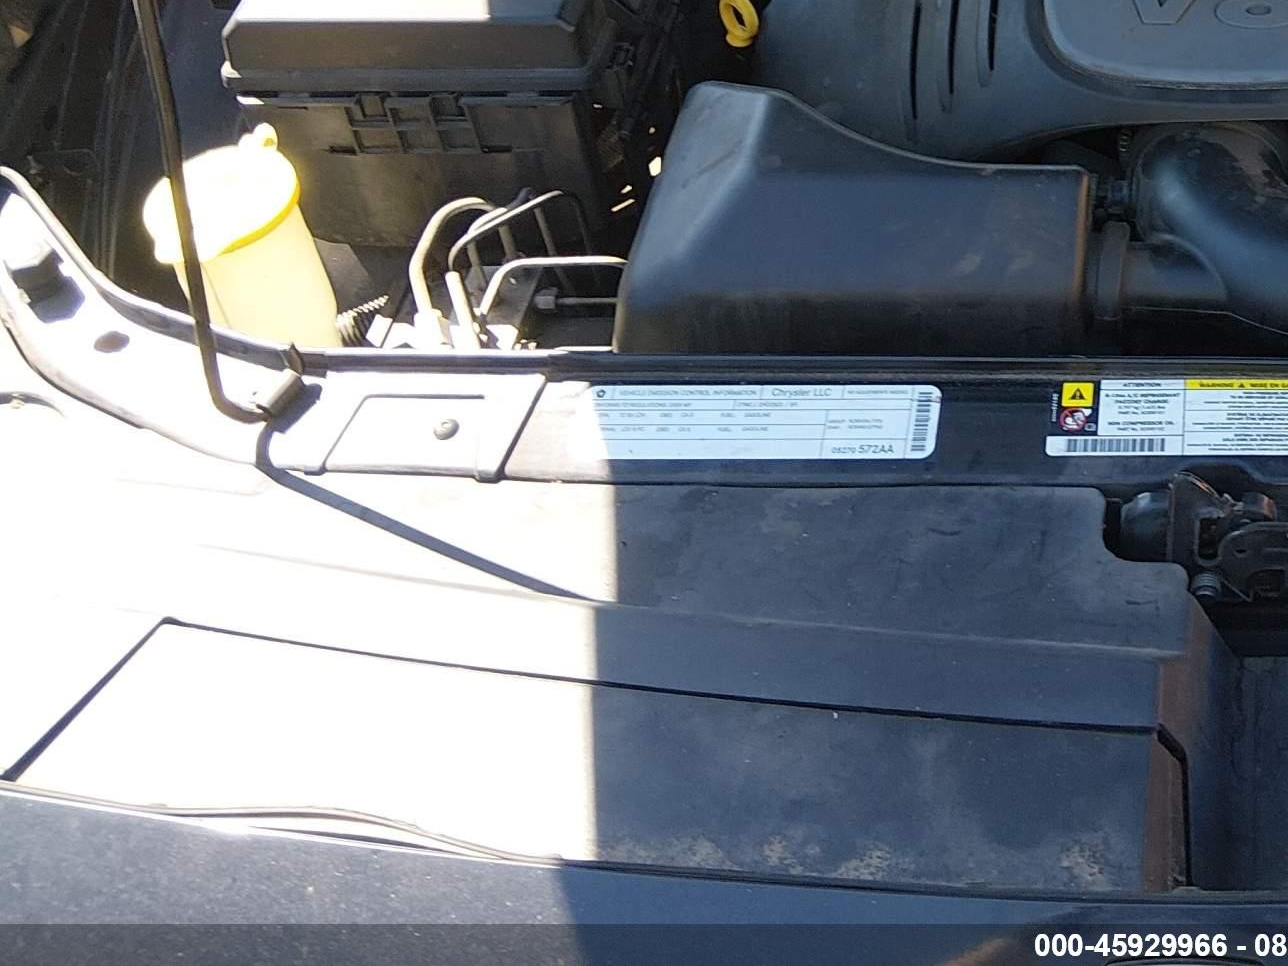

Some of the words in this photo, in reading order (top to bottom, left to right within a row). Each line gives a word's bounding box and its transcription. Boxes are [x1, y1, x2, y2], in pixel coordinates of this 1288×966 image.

[771, 388, 811, 398] Chrysler
[813, 388, 832, 397] LLC
[858, 444, 895, 454] 572AA
